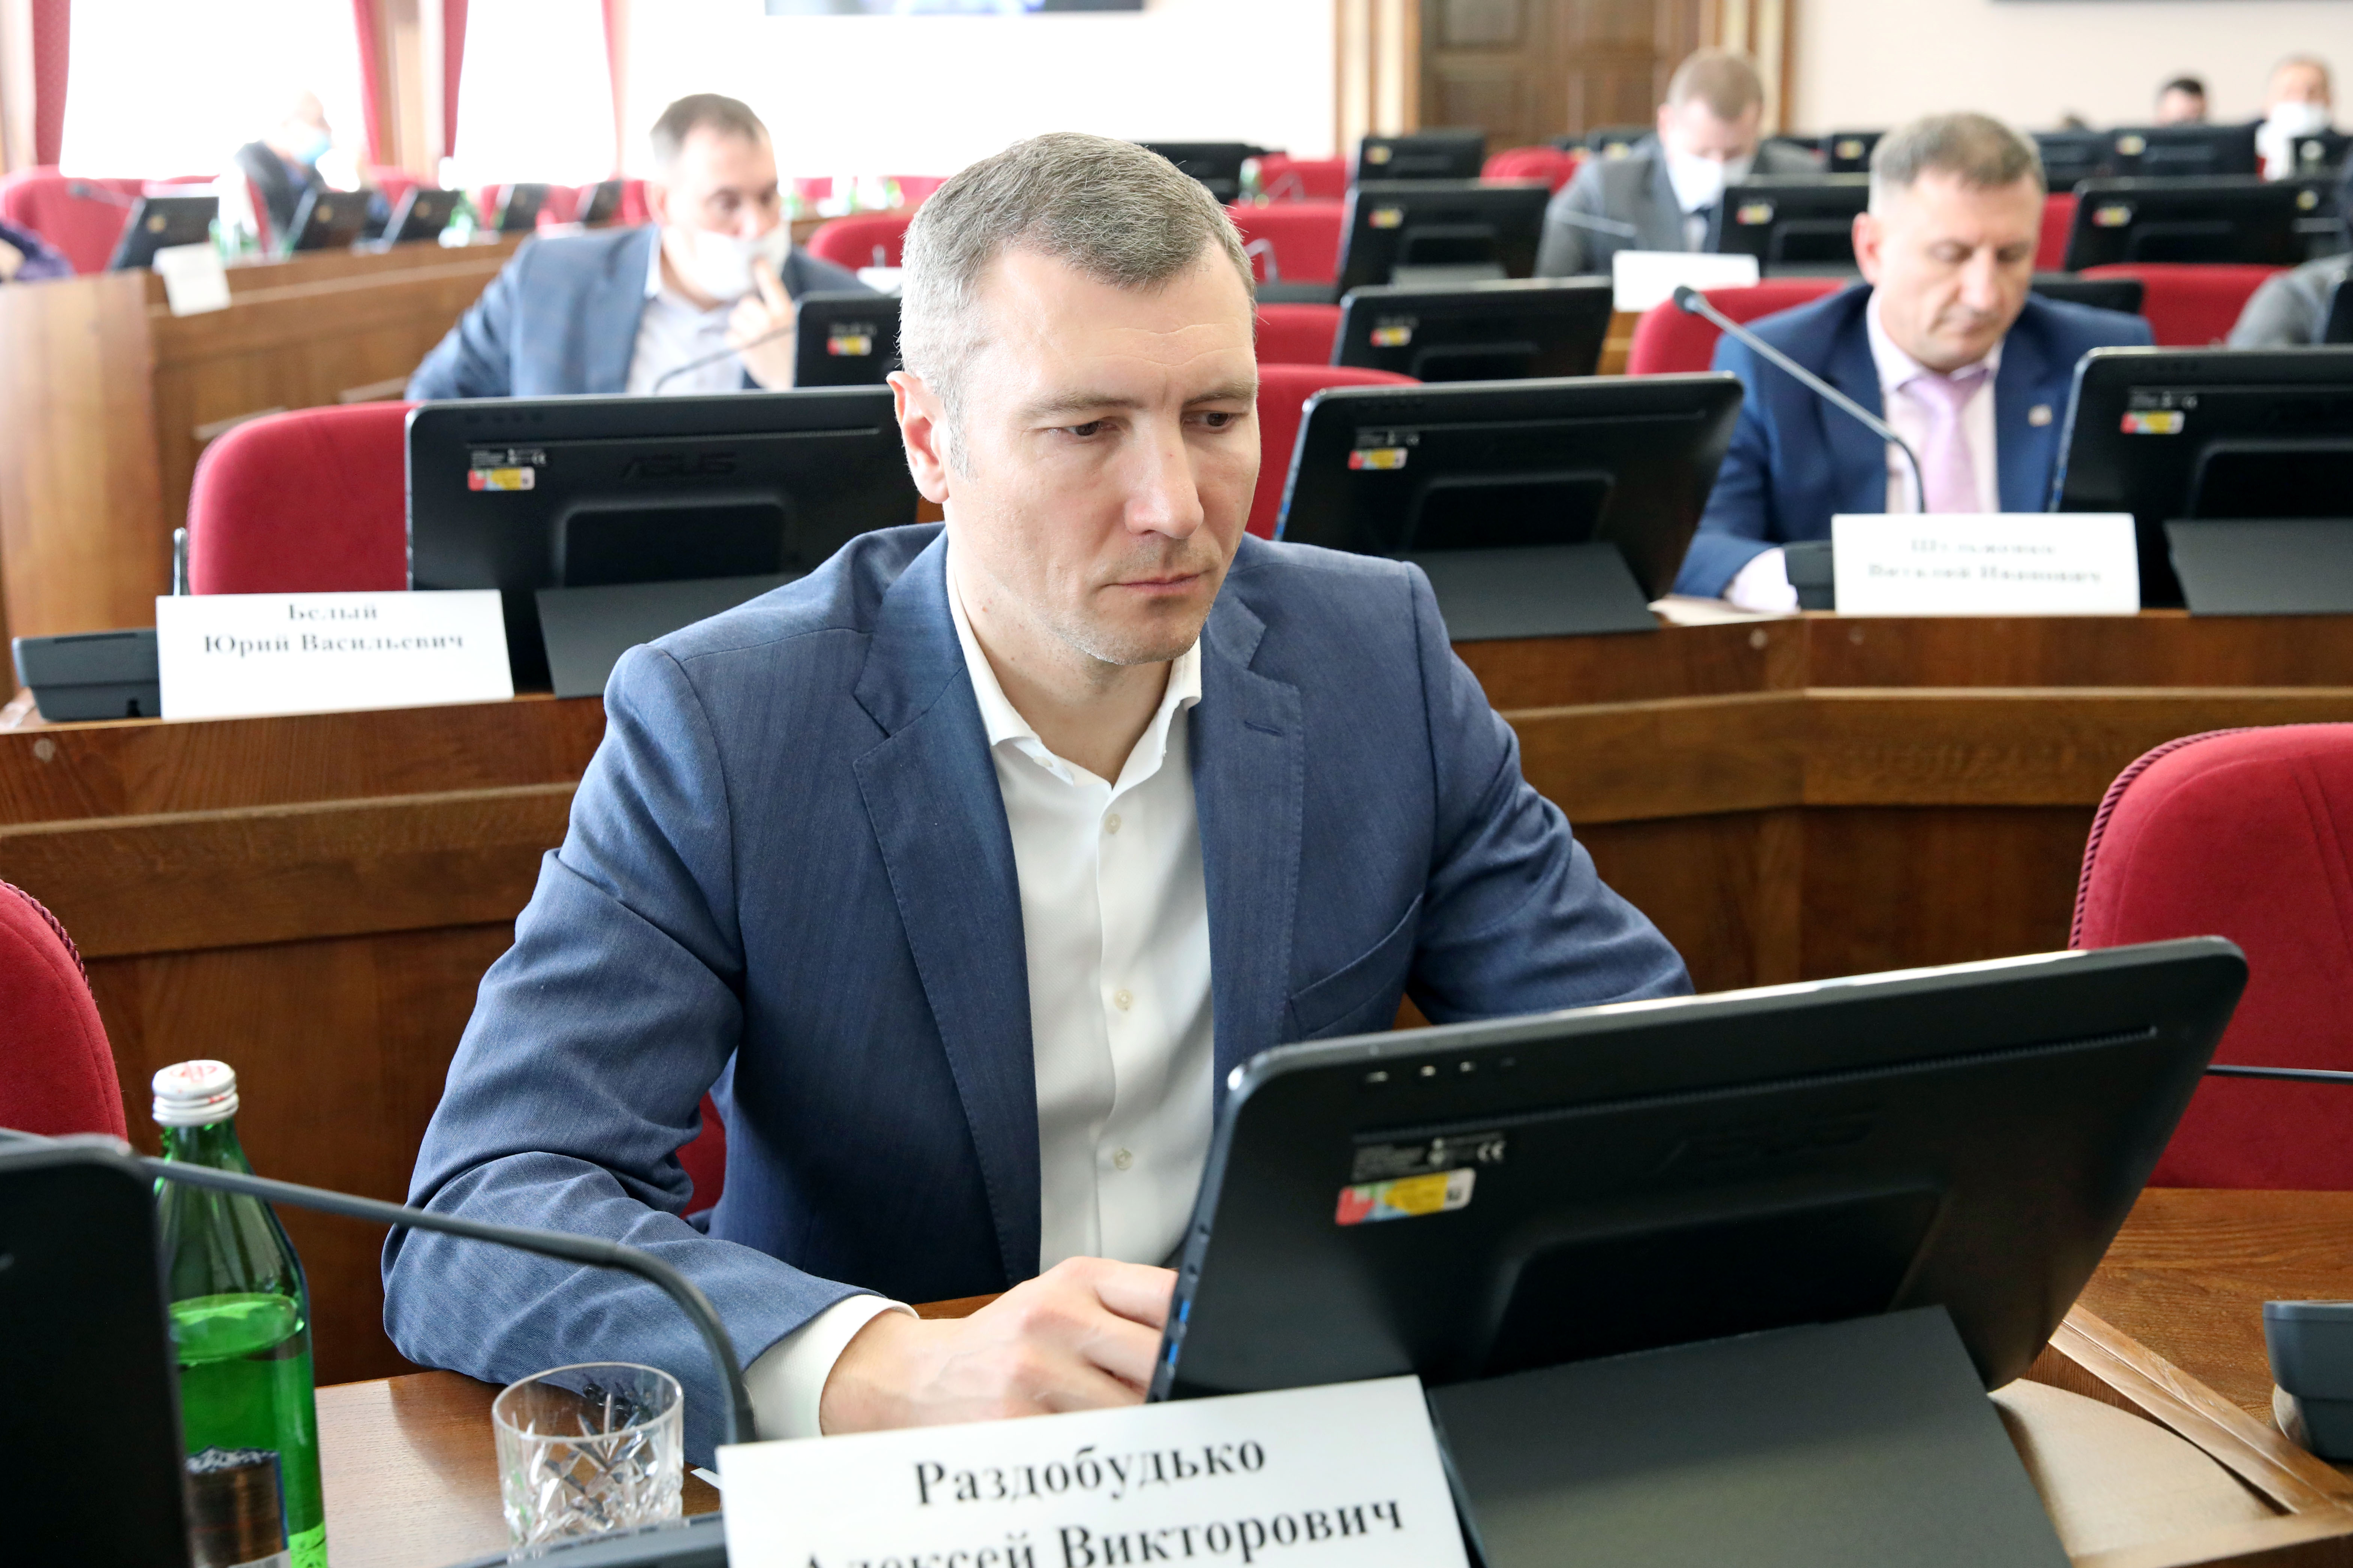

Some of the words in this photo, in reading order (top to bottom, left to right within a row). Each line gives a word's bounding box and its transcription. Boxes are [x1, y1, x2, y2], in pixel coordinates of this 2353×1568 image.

[205, 634, 289, 658] Юрий
[301, 634, 463, 651] Васильевич
[913, 1439, 1266, 1505] Раздобудько
[1057, 1500, 1404, 1568] Викторович
